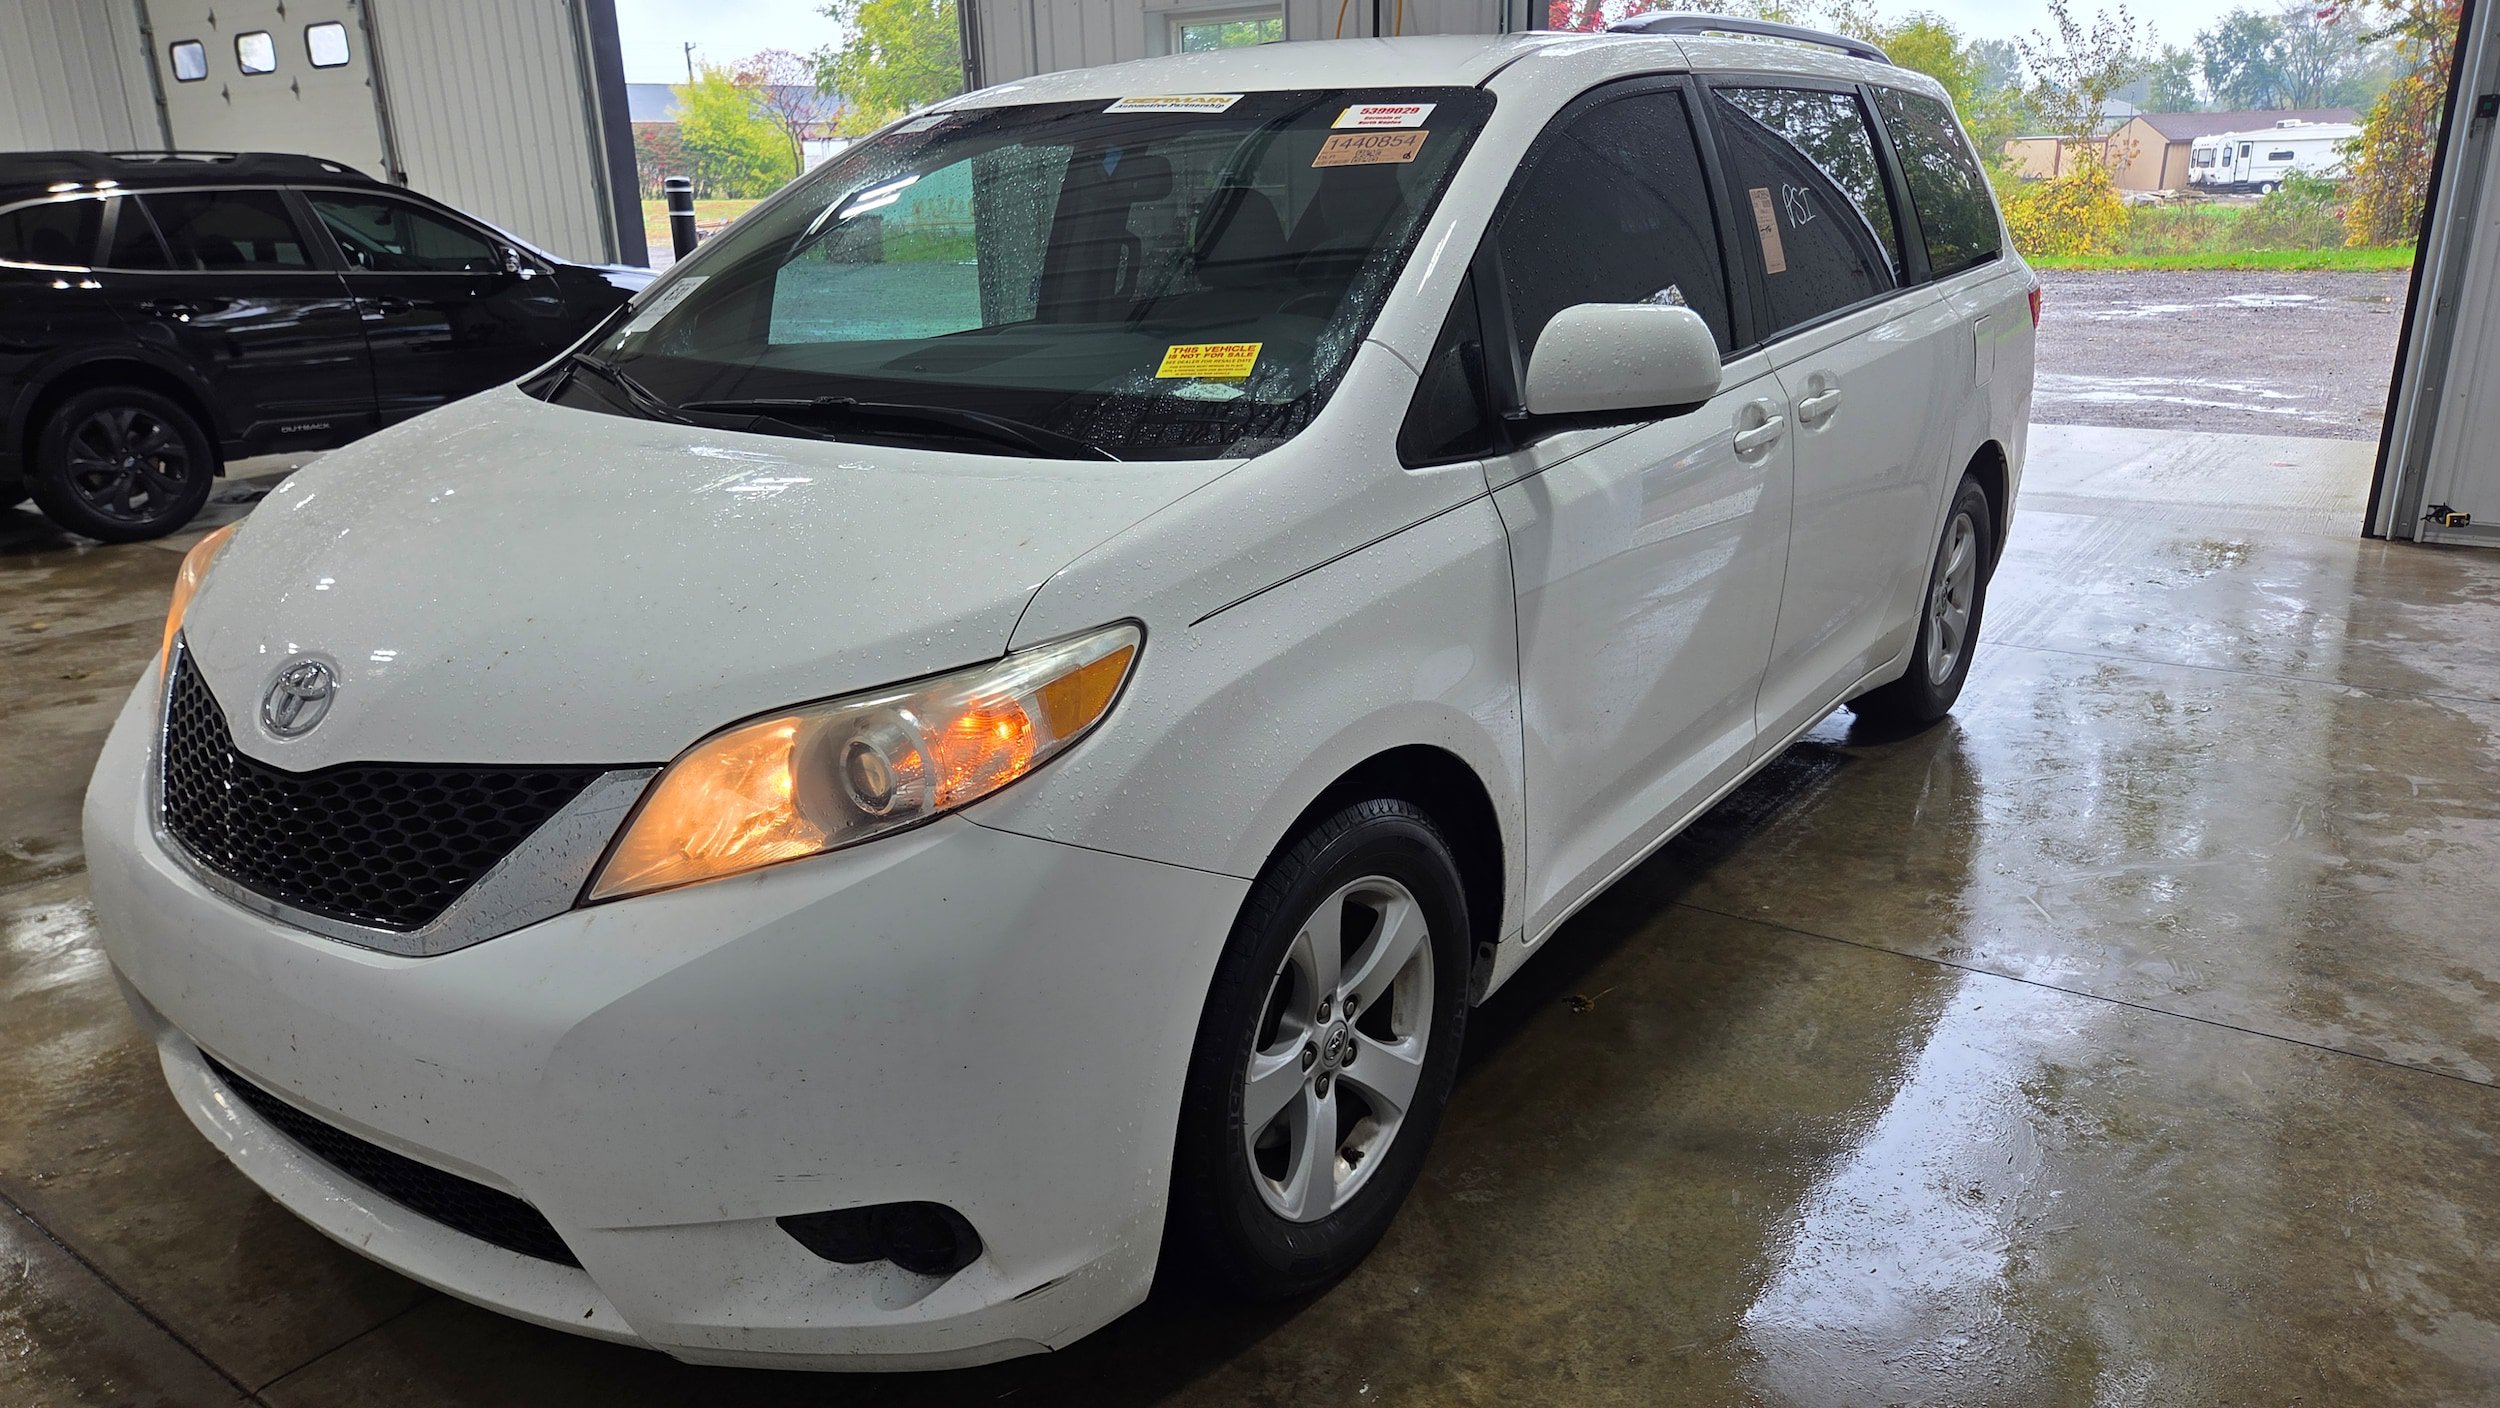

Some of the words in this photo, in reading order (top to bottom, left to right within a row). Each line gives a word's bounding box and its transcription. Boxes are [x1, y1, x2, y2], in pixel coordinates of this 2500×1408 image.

[1360, 107, 1421, 115] 5399029
[1330, 134, 1418, 151] 1440854
[1204, 345, 1257, 353] VEHICLE
[281, 423, 330, 433] OUTBACK
